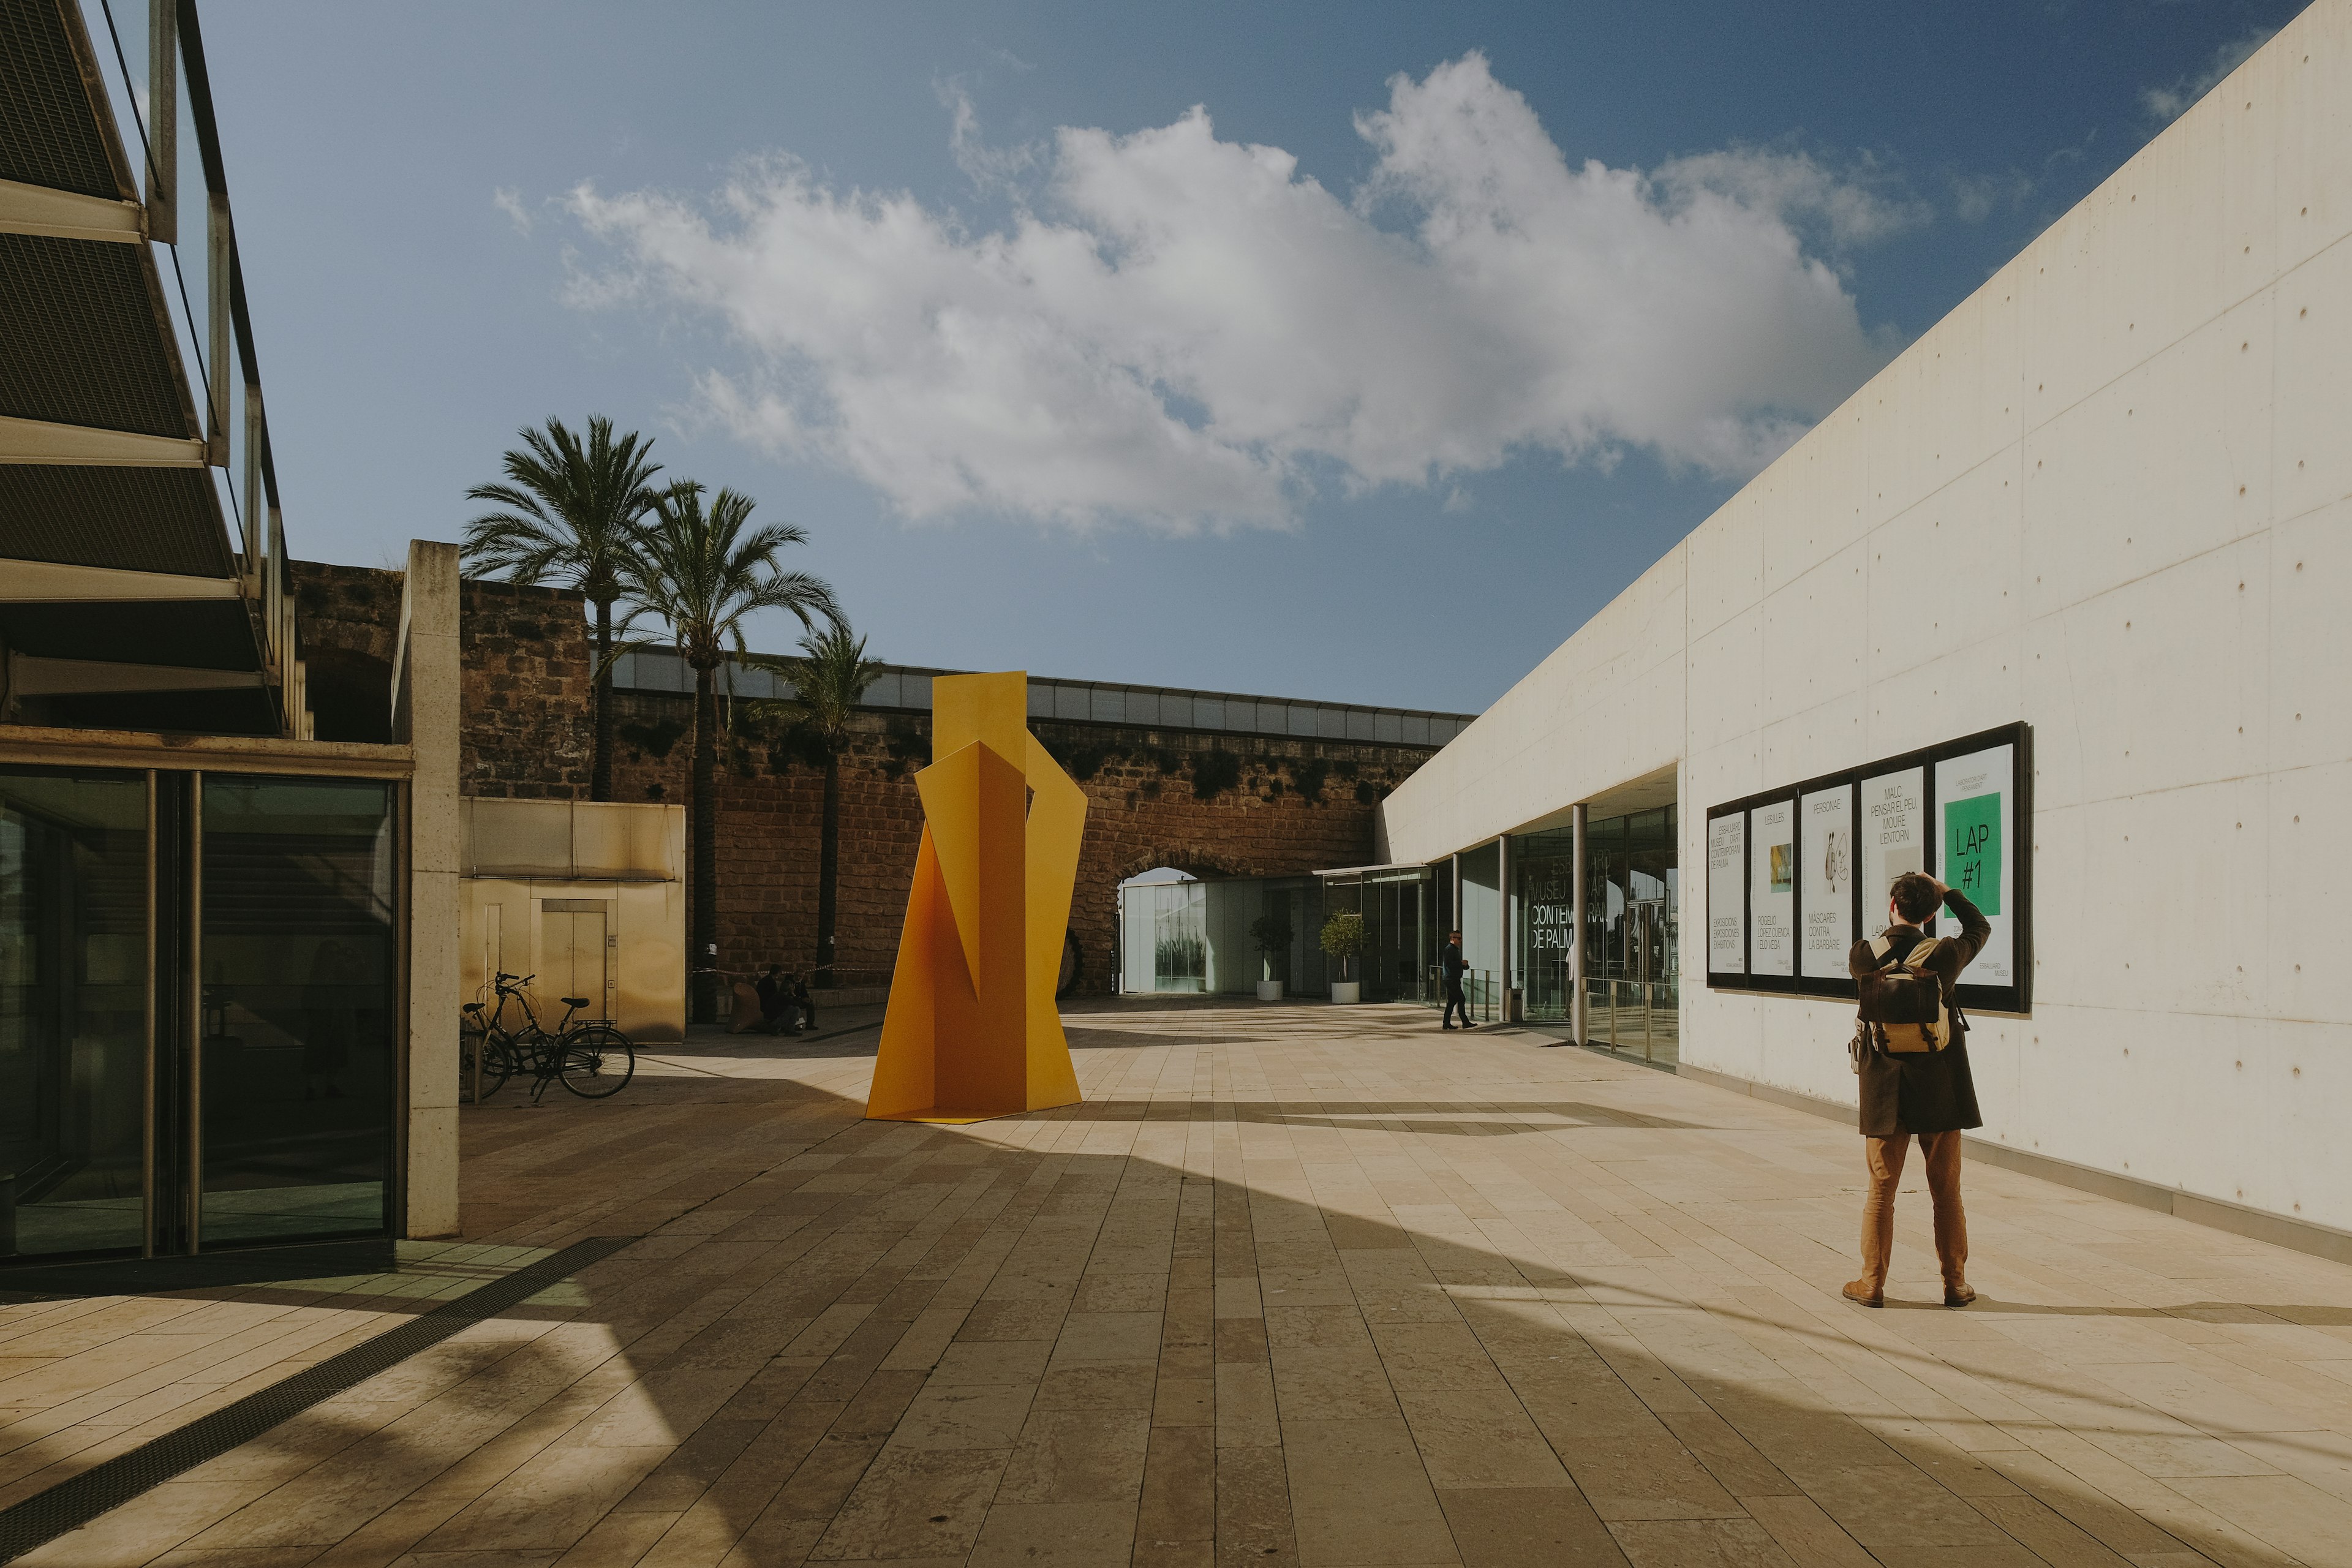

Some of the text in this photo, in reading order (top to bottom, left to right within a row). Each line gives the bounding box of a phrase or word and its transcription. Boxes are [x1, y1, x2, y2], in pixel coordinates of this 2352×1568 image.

[1813, 799, 1841, 815] PERSONAE
[1871, 802, 1895, 817] PENSAR
[1896, 801, 1904, 813] EL
[1883, 814, 1905, 829] MOURE
[1880, 829, 1909, 845] L'ENTORN
[1956, 824, 1989, 856] LAP
[1962, 859, 1981, 890] #1
[1531, 879, 1566, 901] MUSEU
[1546, 928, 1573, 949] PALM
[1808, 925, 1830, 937] CONTRA
[1768, 940, 1781, 949] VEGA
[1809, 939, 1815, 950] LA
